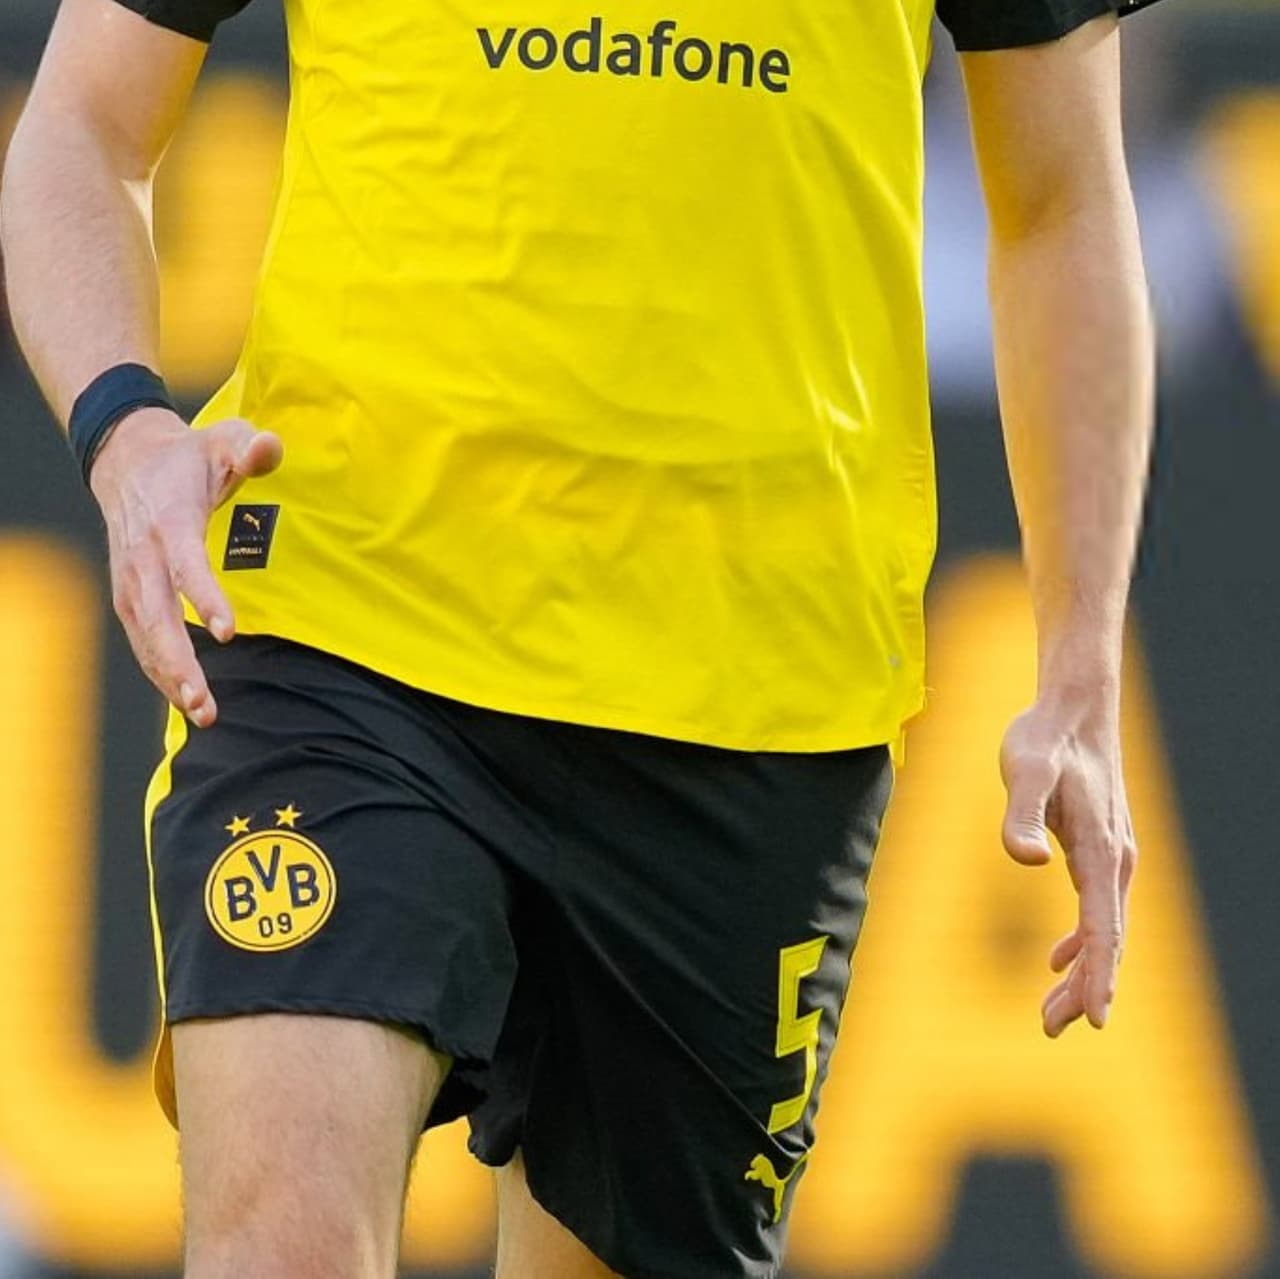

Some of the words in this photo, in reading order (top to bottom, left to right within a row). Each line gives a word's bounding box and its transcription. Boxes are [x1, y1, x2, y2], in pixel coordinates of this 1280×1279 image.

[476, 17, 791, 93] vodafone
[224, 845, 320, 922] BVB
[258, 912, 293, 938] 09
[767, 935, 830, 1135] 5
